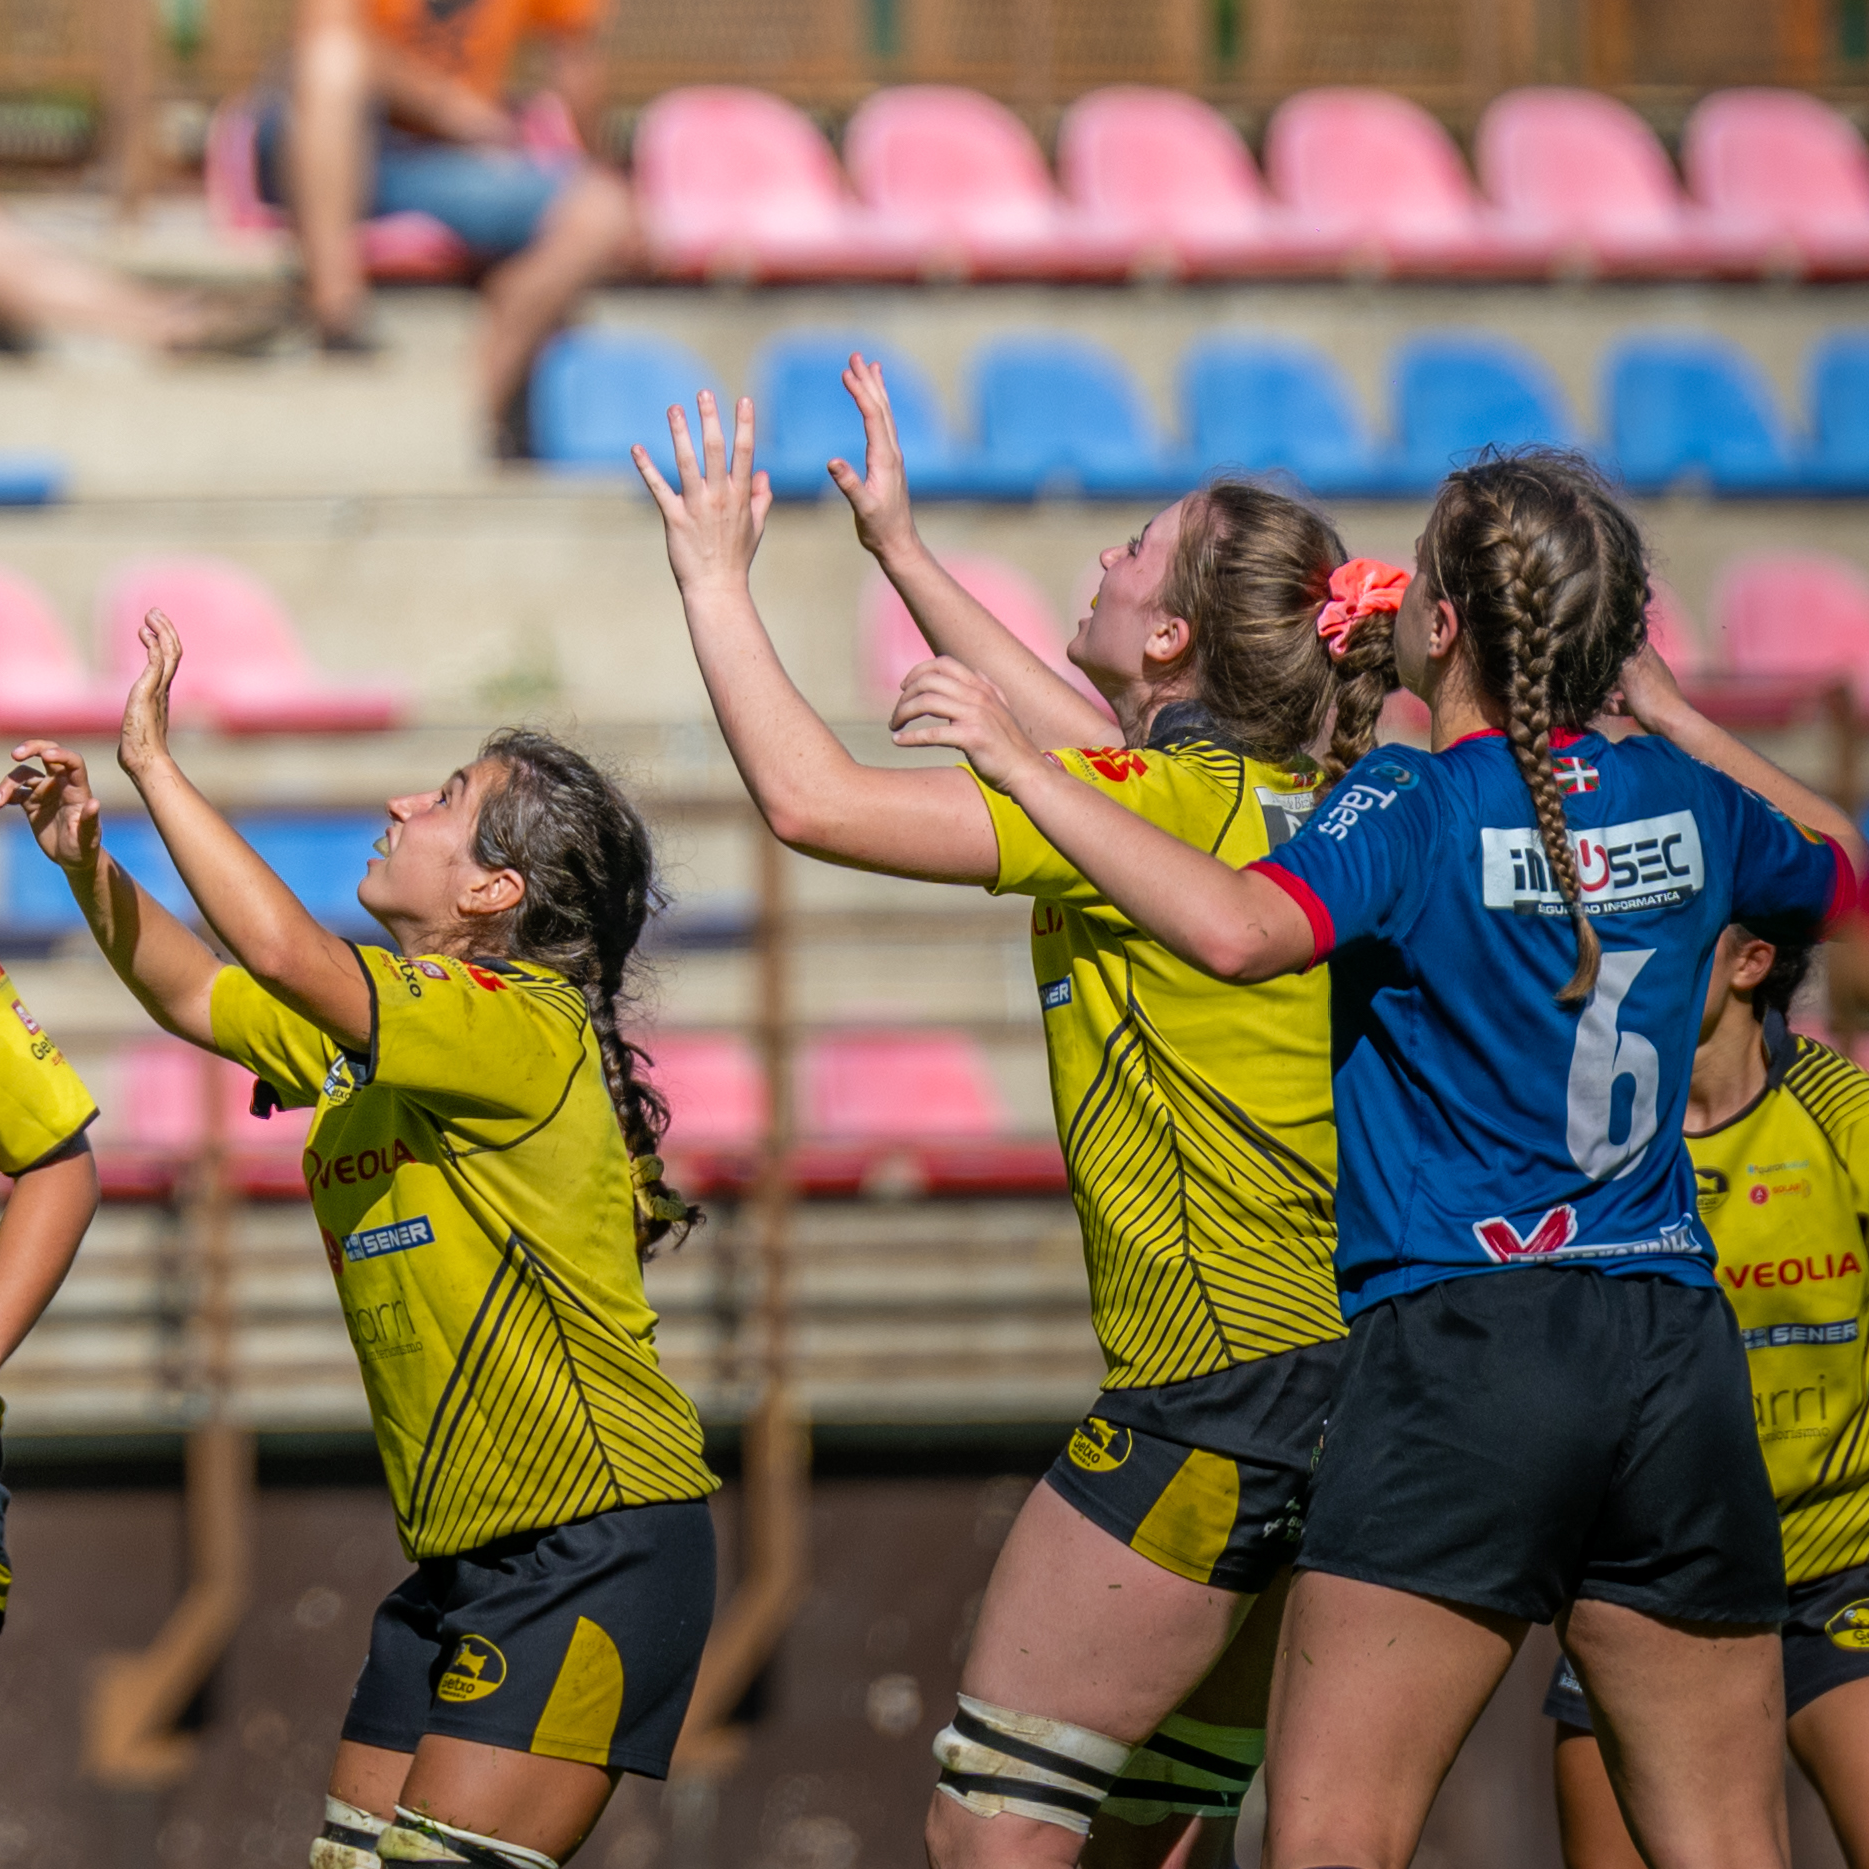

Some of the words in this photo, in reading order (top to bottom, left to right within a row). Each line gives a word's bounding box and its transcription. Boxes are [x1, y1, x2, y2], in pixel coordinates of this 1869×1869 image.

[1567, 948, 1660, 1180] 6
[318, 1137, 418, 1189] VEOLA
[363, 1221, 429, 1254] SENER
[1723, 1251, 1863, 1290] VEOLIA
[1771, 1322, 1859, 1344] SENER
